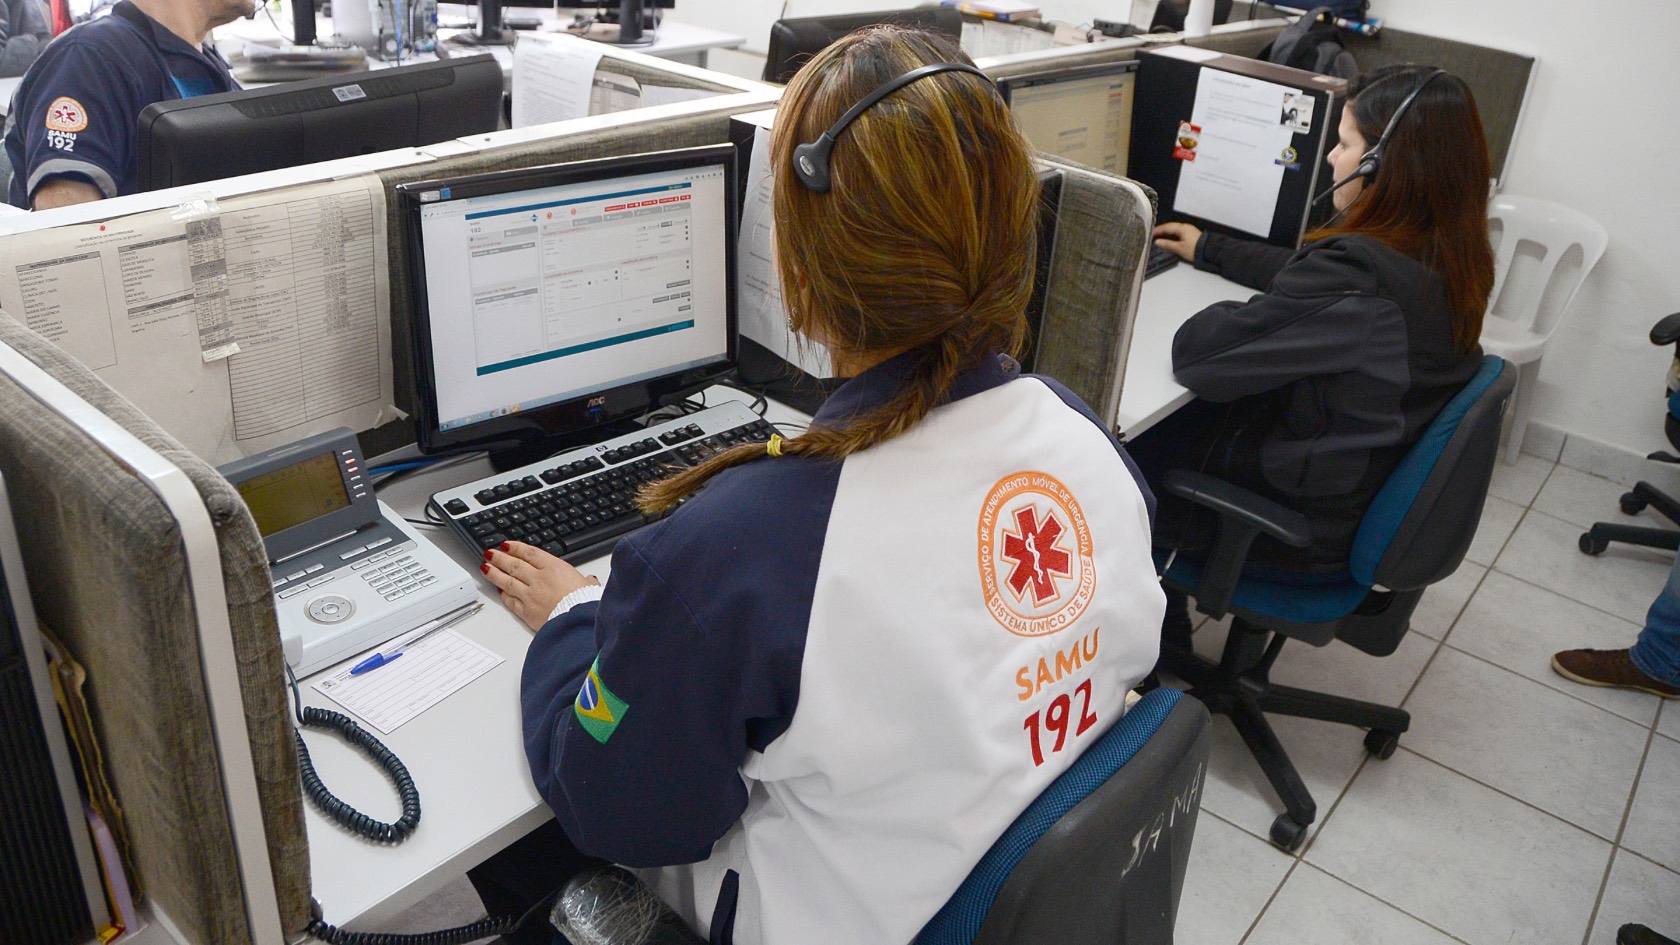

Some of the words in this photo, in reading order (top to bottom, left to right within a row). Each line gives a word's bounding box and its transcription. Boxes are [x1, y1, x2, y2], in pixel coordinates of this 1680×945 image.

[47, 136, 74, 152] 192
[48, 130, 76, 140] SAMU
[983, 476, 1028, 526] ATENDIMENTO
[1032, 476, 1058, 494] MÓVEL
[1058, 490, 1070, 502] DE
[981, 526, 989, 542] DE
[1068, 498, 1088, 553] URGÊNCIA
[982, 546, 995, 595] SERVIÇO
[991, 598, 1027, 632] SISTEMA
[1068, 600, 1083, 616] DE
[1016, 626, 1100, 701] SAMU
[1024, 678, 1098, 767] 192
